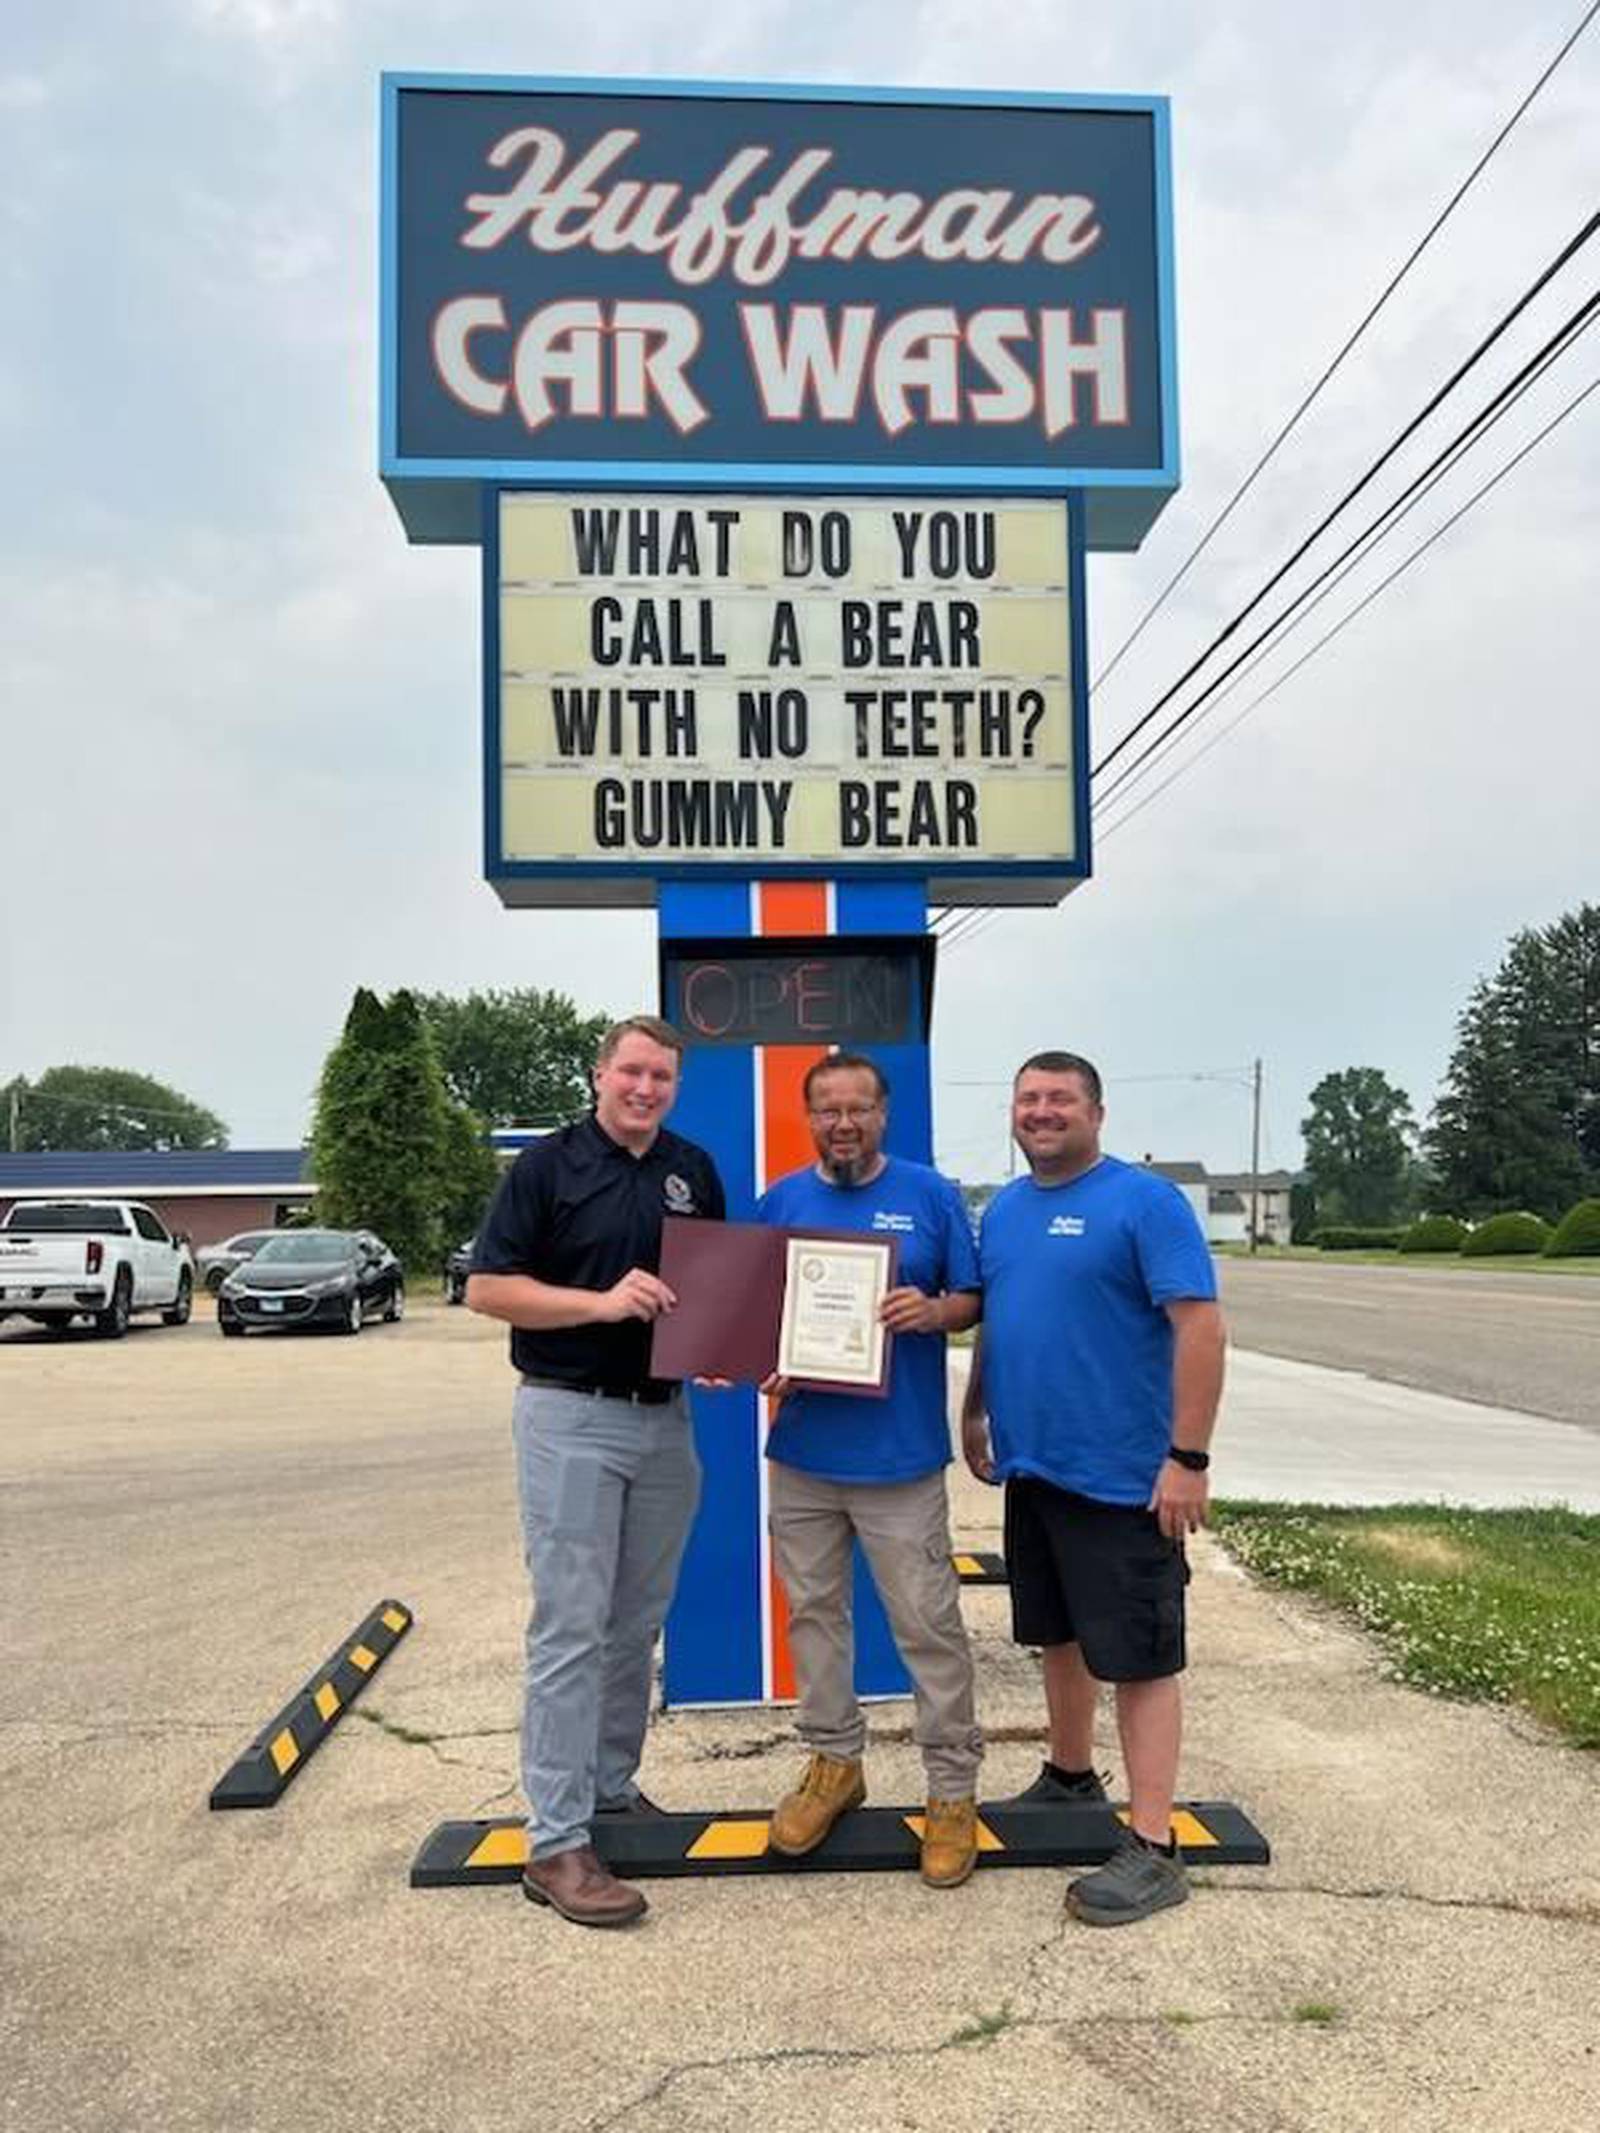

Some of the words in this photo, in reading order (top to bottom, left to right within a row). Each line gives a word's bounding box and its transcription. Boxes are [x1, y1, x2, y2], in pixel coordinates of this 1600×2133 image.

[460, 126, 1102, 287] Huffman
[431, 294, 711, 434] CAR
[739, 301, 1131, 441] WASH
[572, 508, 741, 577] WHAT
[782, 511, 852, 578] DO
[892, 511, 996, 579] YOU
[591, 597, 727, 667] CALL
[768, 601, 801, 667] A
[841, 601, 981, 668] BEAR
[551, 688, 697, 757] WITH
[738, 690, 808, 758] NO
[845, 690, 1046, 758] TEETH?
[593, 778, 793, 848] GUMMY
[840, 781, 979, 848] BEAR
[685, 963, 892, 1035] OPEN
